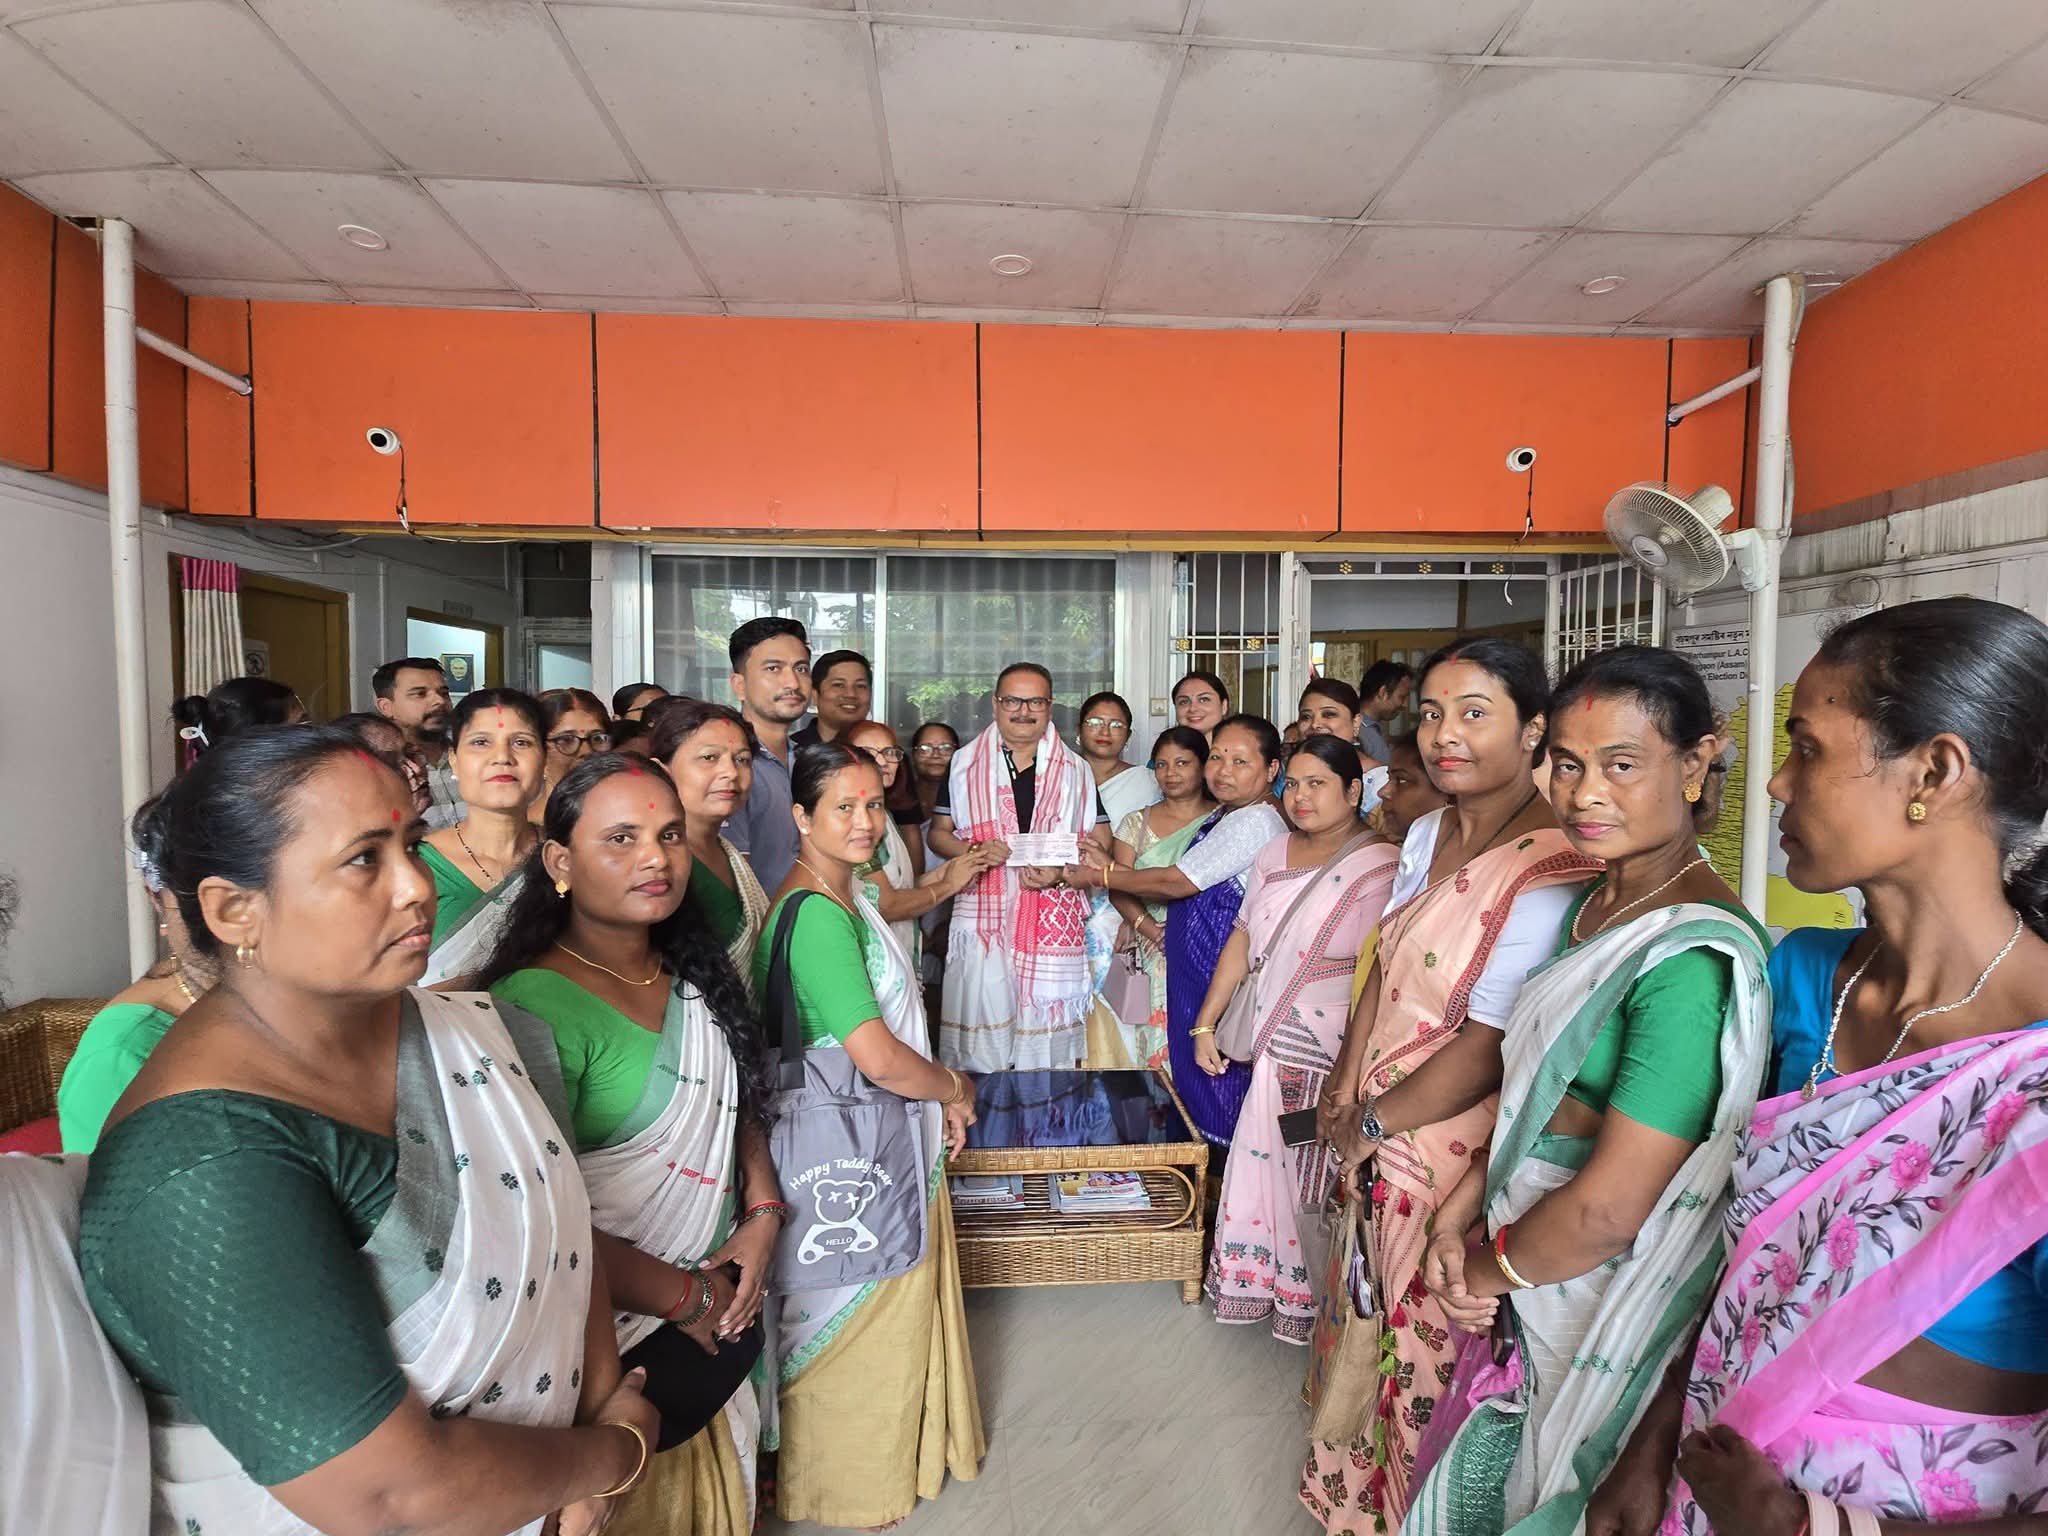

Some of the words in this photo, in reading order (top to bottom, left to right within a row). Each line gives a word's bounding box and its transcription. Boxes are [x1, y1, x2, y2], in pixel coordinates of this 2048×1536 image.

[1707, 672, 1738, 681] Election
[789, 1162, 830, 1190] Happy
[833, 1157, 873, 1174] Teddy
[872, 1163, 893, 1187] Bear
[825, 1236, 853, 1246] HELLO
